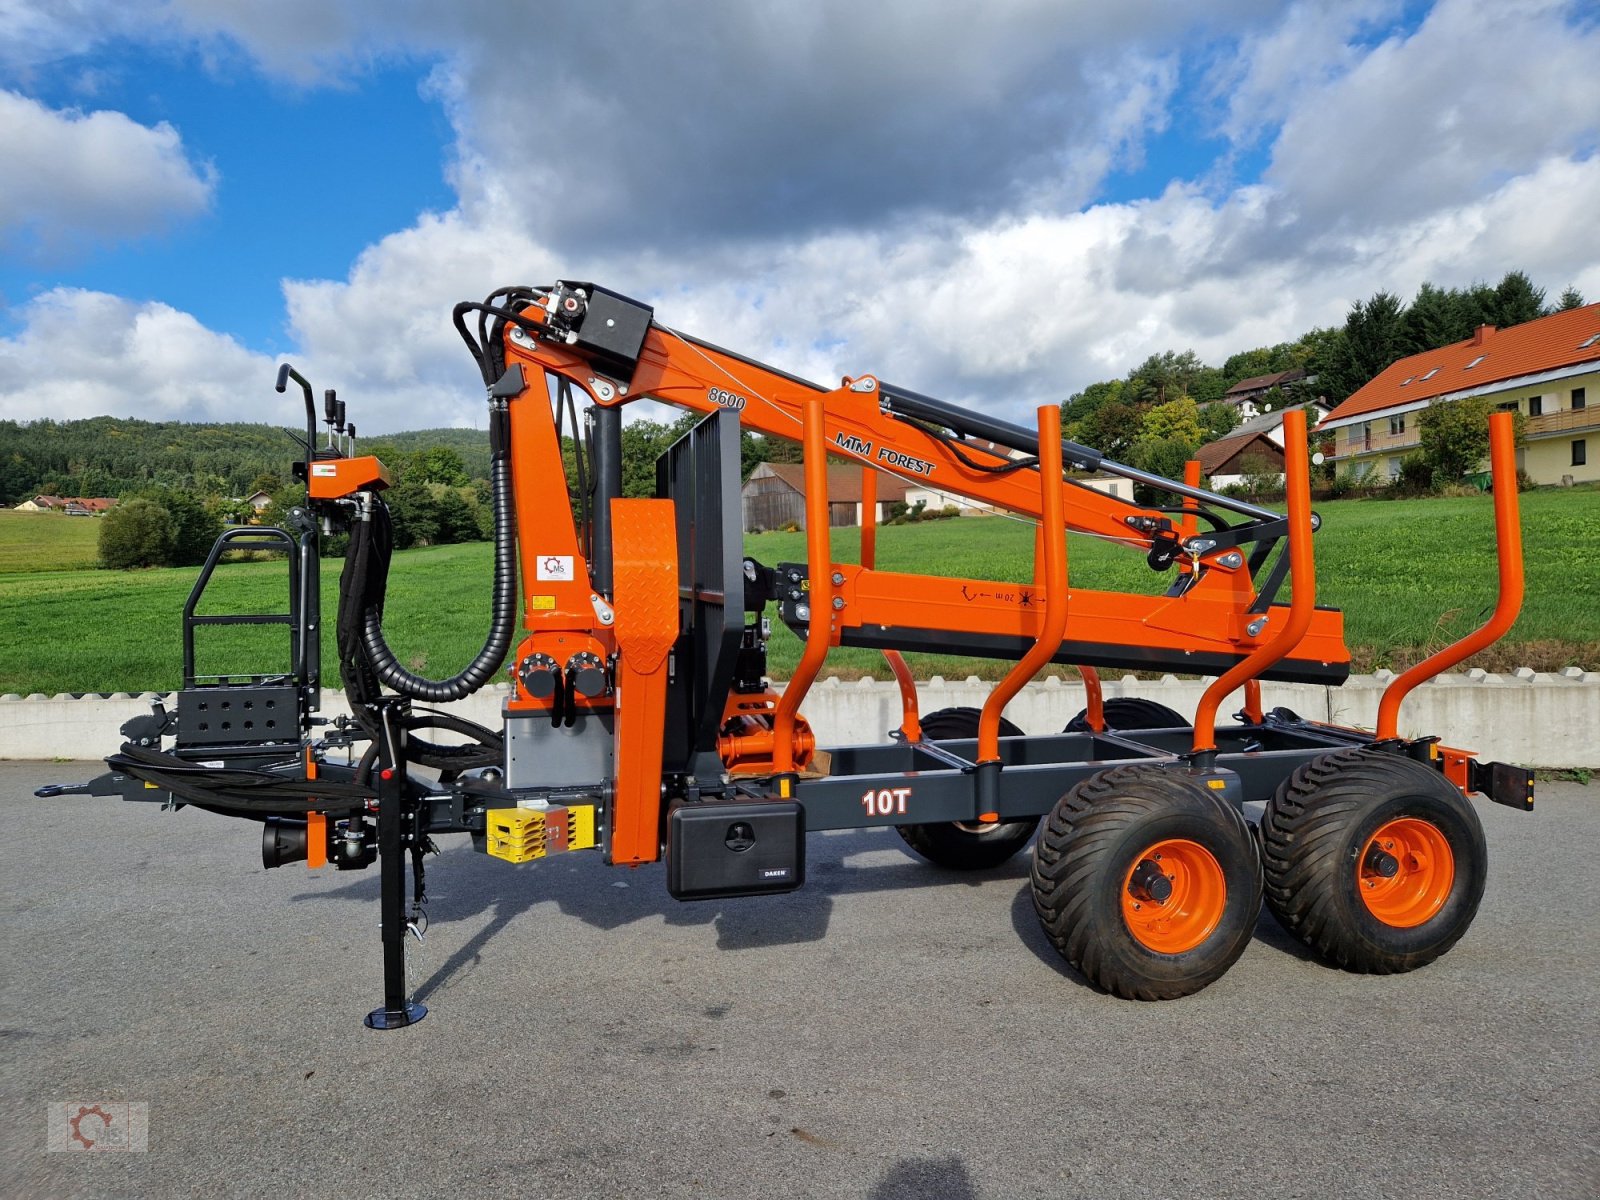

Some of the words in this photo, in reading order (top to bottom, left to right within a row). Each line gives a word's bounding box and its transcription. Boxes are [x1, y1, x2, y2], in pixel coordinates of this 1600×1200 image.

[708, 387, 746, 410] 8600
[836, 432, 872, 456] MTM
[877, 447, 936, 476] FOREST
[862, 787, 912, 816] 10T
[764, 870, 786, 878] DAKEN
